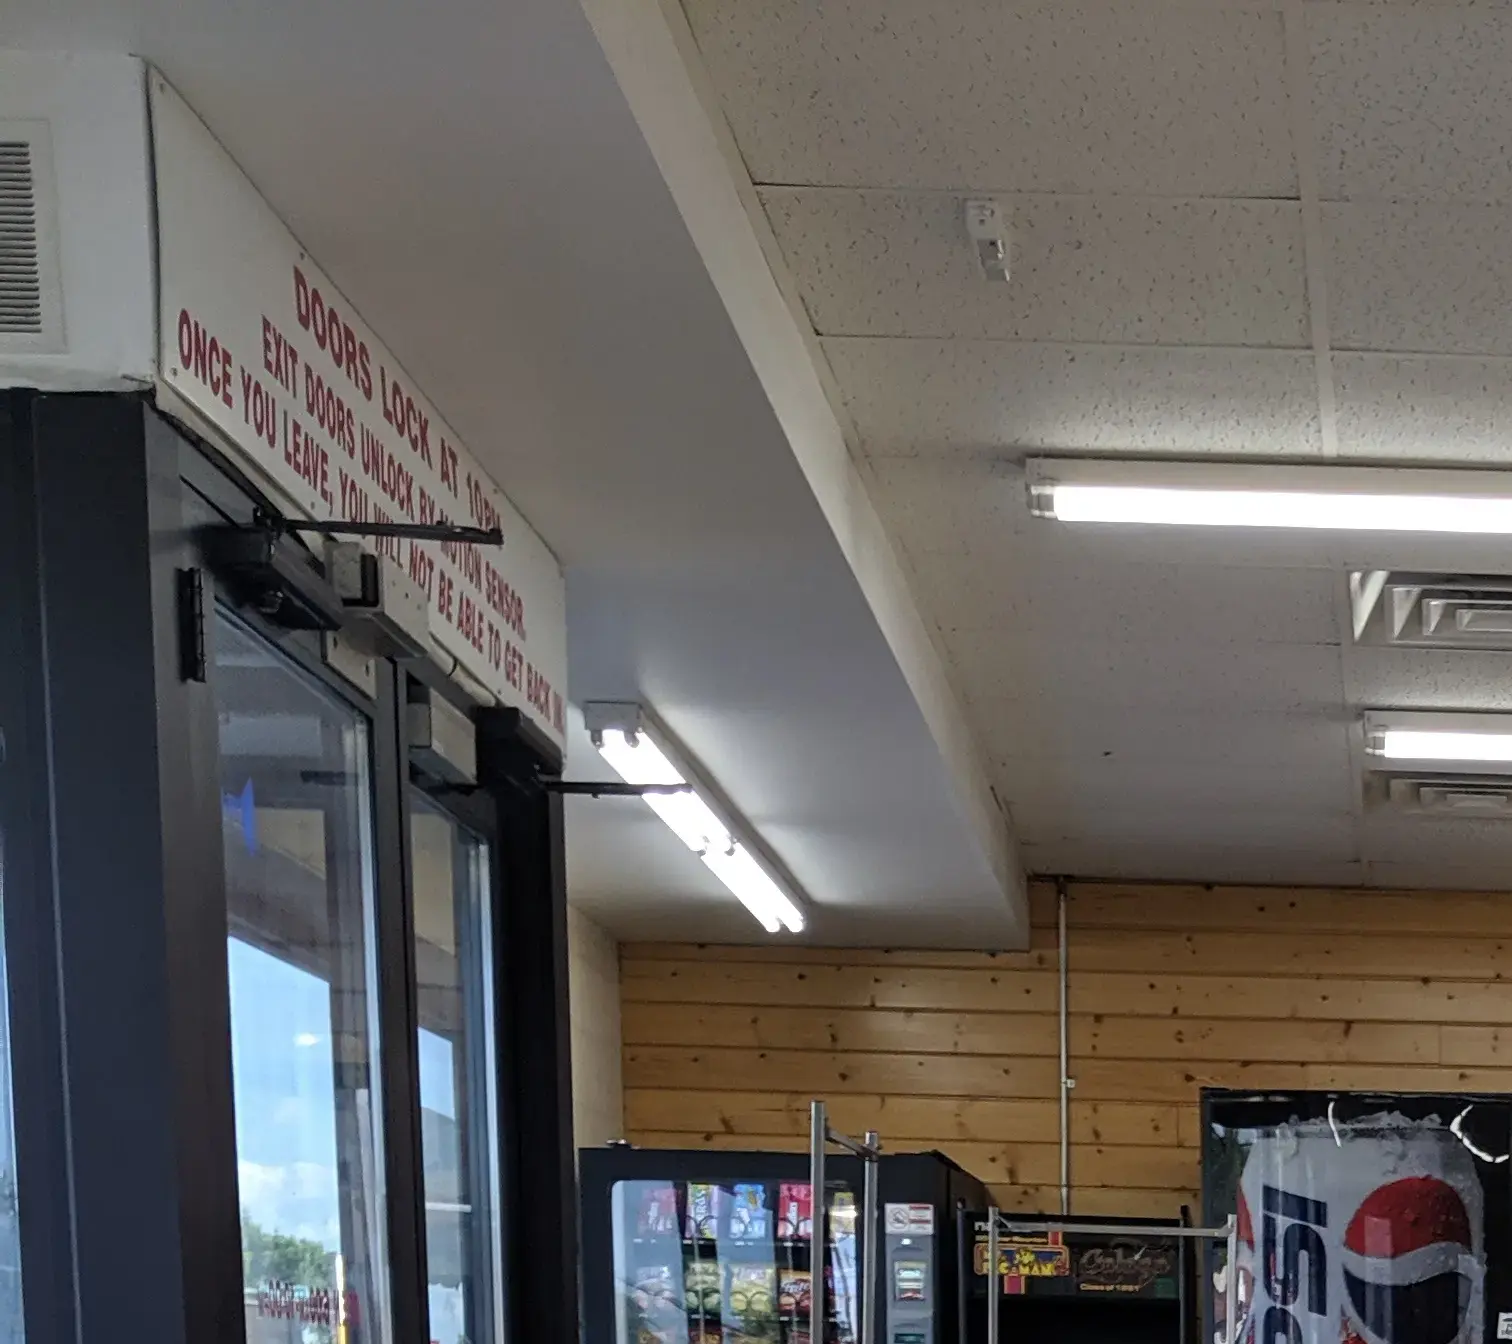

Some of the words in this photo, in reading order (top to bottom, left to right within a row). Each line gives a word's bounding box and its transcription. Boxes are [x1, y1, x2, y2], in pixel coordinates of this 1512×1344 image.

[261, 314, 298, 399] EXIT
[305, 362, 355, 460] DOORS
[361, 421, 415, 523] UNLOCK
[419, 486, 435, 525] BY
[293, 264, 373, 402] DOORS
[380, 365, 433, 471] LOCK
[440, 437, 459, 499] AT
[178, 308, 234, 410] ONCE
[240, 364, 277, 450] YOU
[283, 409, 334, 517] LEAVE,
[339, 466, 369, 539] YOU
[409, 541, 434, 602] NOT
[438, 568, 454, 624] BE
[457, 591, 485, 655] ABLE
[487, 620, 501, 672] TO
[504, 640, 523, 692] GET
[527, 661, 551, 722] BACK
